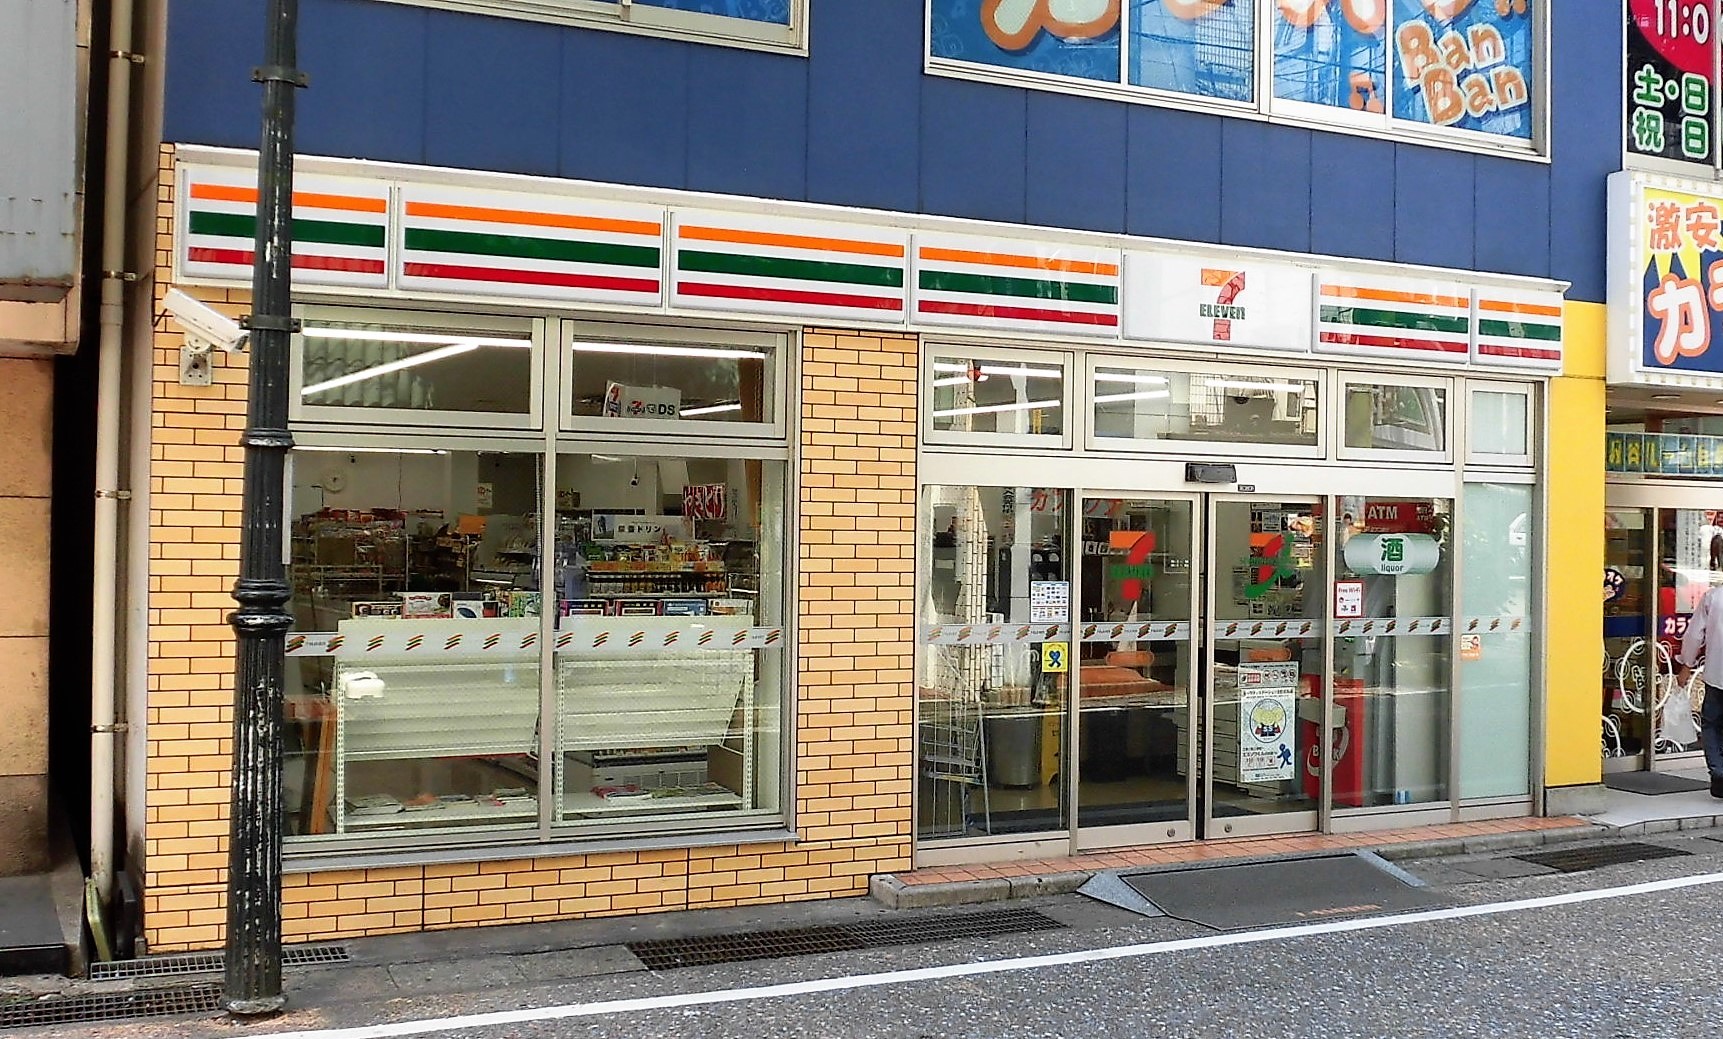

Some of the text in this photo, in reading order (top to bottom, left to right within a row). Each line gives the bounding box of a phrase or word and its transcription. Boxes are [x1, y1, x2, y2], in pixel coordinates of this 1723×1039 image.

[1397, 21, 1505, 86] Ban
[1421, 65, 1527, 124] Ban
[1647, 201, 1719, 252] 激安
[1200, 268, 1246, 341] 7
[1648, 262, 1723, 365] カ
[1367, 506, 1398, 520] ATM
[1381, 537, 1404, 562] 酒
[1381, 564, 1404, 573] liquor
[1664, 616, 1690, 635] カラ
